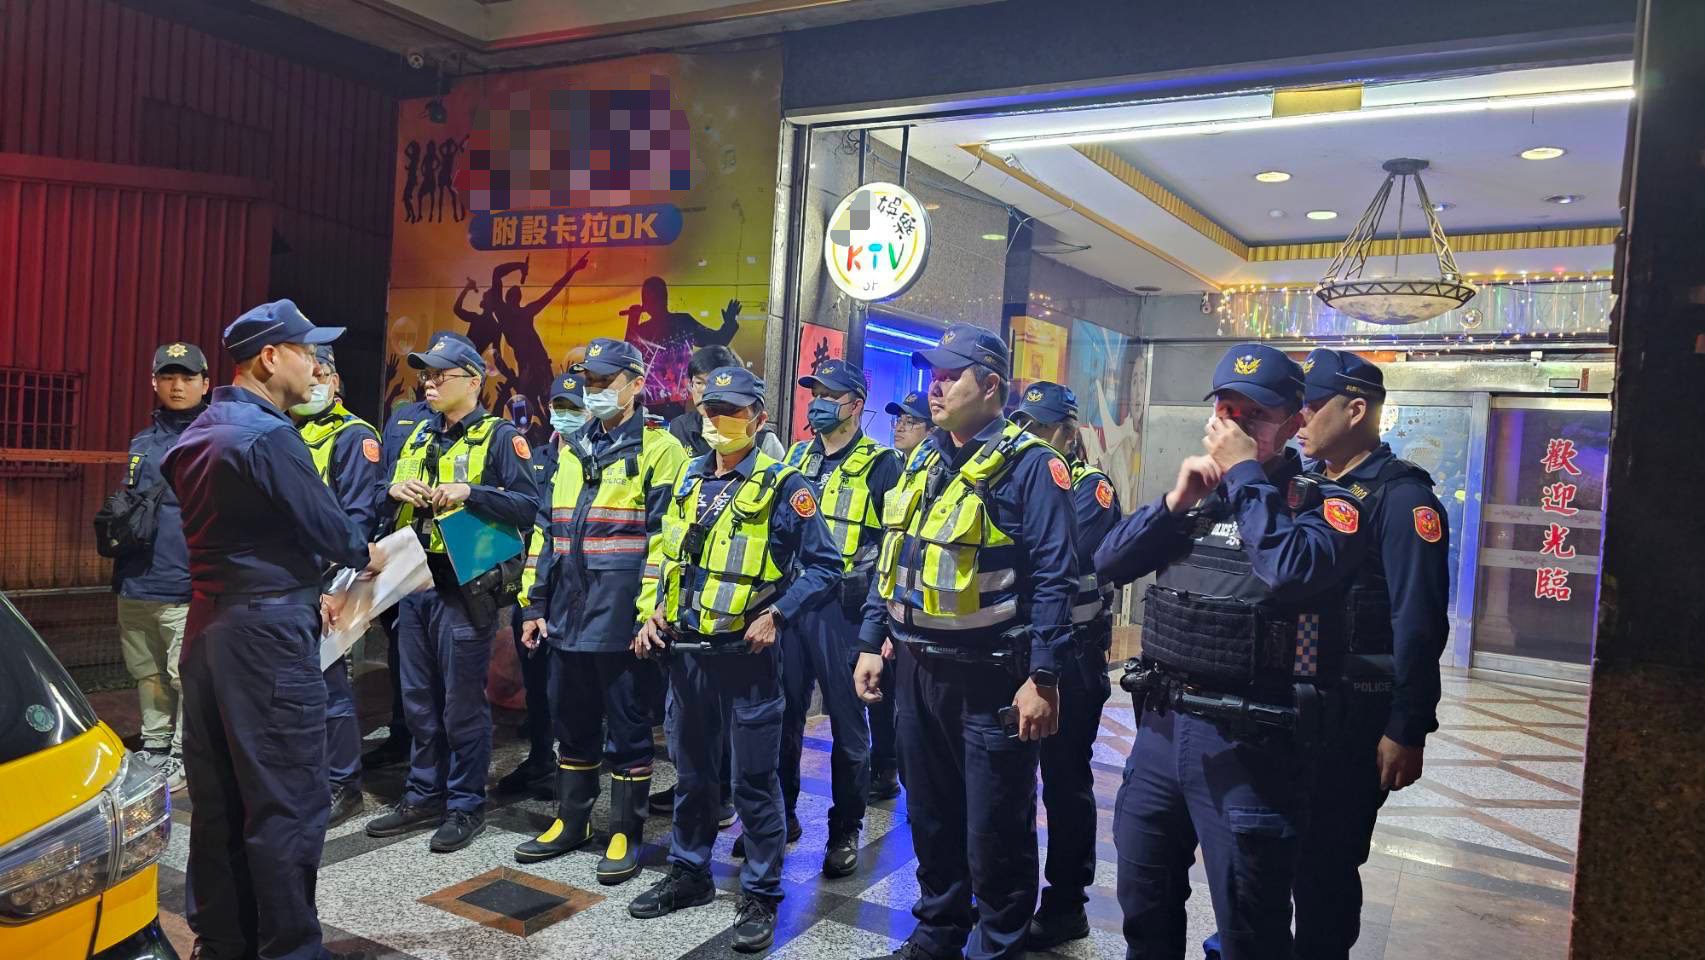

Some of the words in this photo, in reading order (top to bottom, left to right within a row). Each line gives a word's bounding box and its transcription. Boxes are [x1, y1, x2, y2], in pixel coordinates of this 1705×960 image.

[491, 211, 659, 247] 附設卡拉OK
[1535, 438, 1582, 601] 歡迎光臨
[1353, 681, 1393, 693] POLICE
